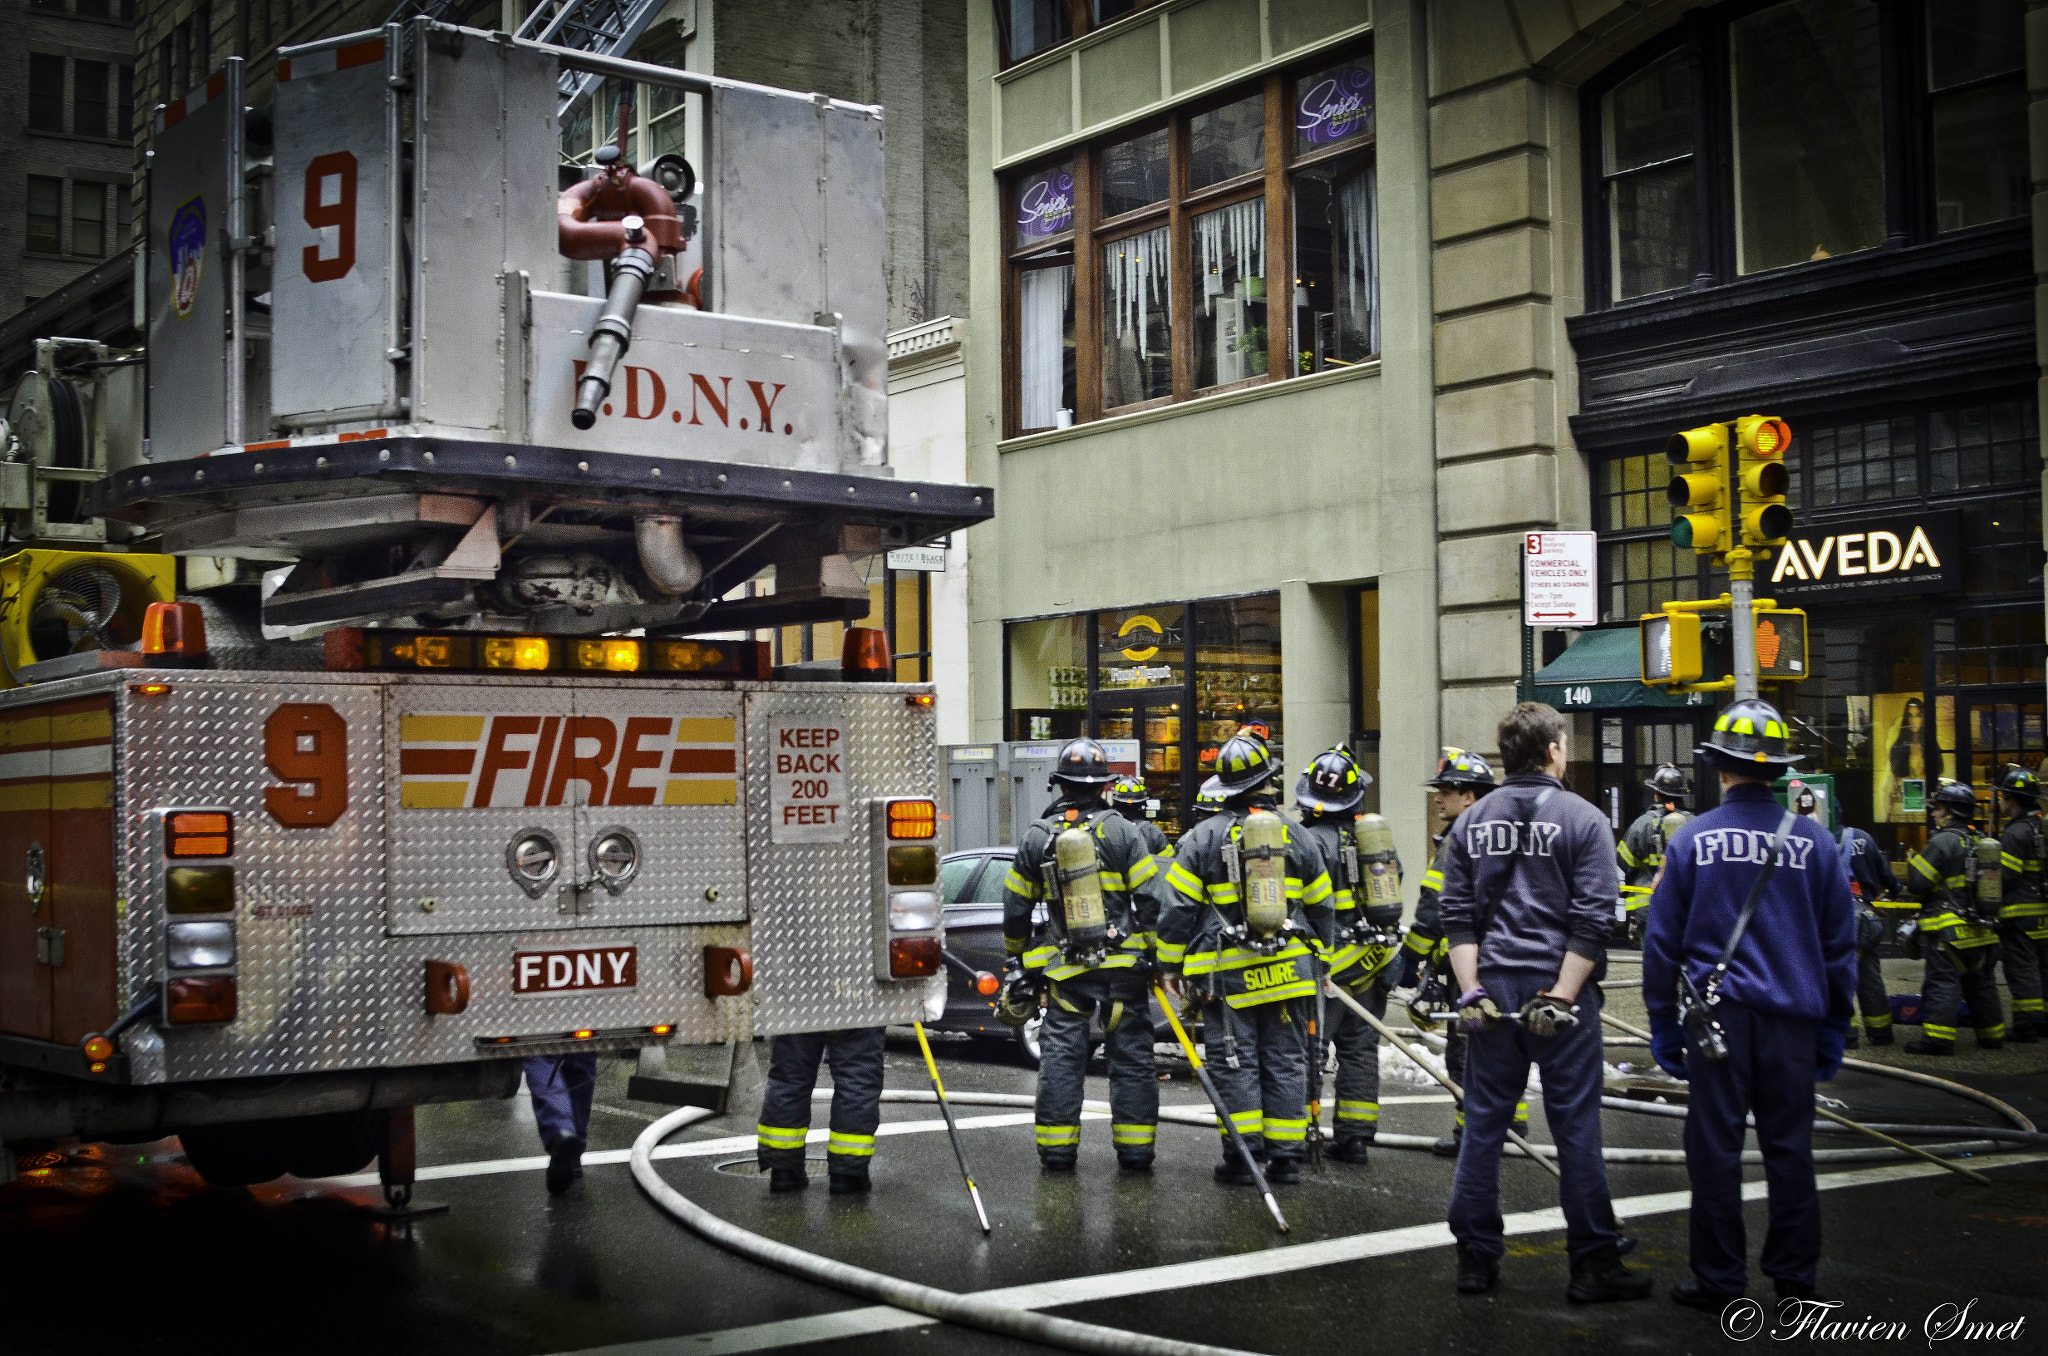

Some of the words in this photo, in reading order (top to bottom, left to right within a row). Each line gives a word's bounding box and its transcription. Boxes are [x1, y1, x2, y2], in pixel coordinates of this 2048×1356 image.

[1297, 79, 1364, 129] Senses
[1018, 181, 1069, 224] Senses
[303, 151, 358, 283] 9
[921, 553, 944, 561] BLACK
[1528, 535, 1541, 554] 3
[1771, 525, 1941, 583] AVEDA
[1530, 569, 1566, 577] VEHICLES
[1564, 686, 1592, 705] 140
[780, 728, 840, 748] KEEP
[264, 703, 348, 828] 9
[473, 716, 673, 808] FIRE
[777, 754, 841, 774] BACK
[791, 780, 829, 799] 200
[783, 805, 840, 825] FEET
[1693, 827, 1814, 870] FDNY
[1243, 960, 1299, 990] SQUIRE
